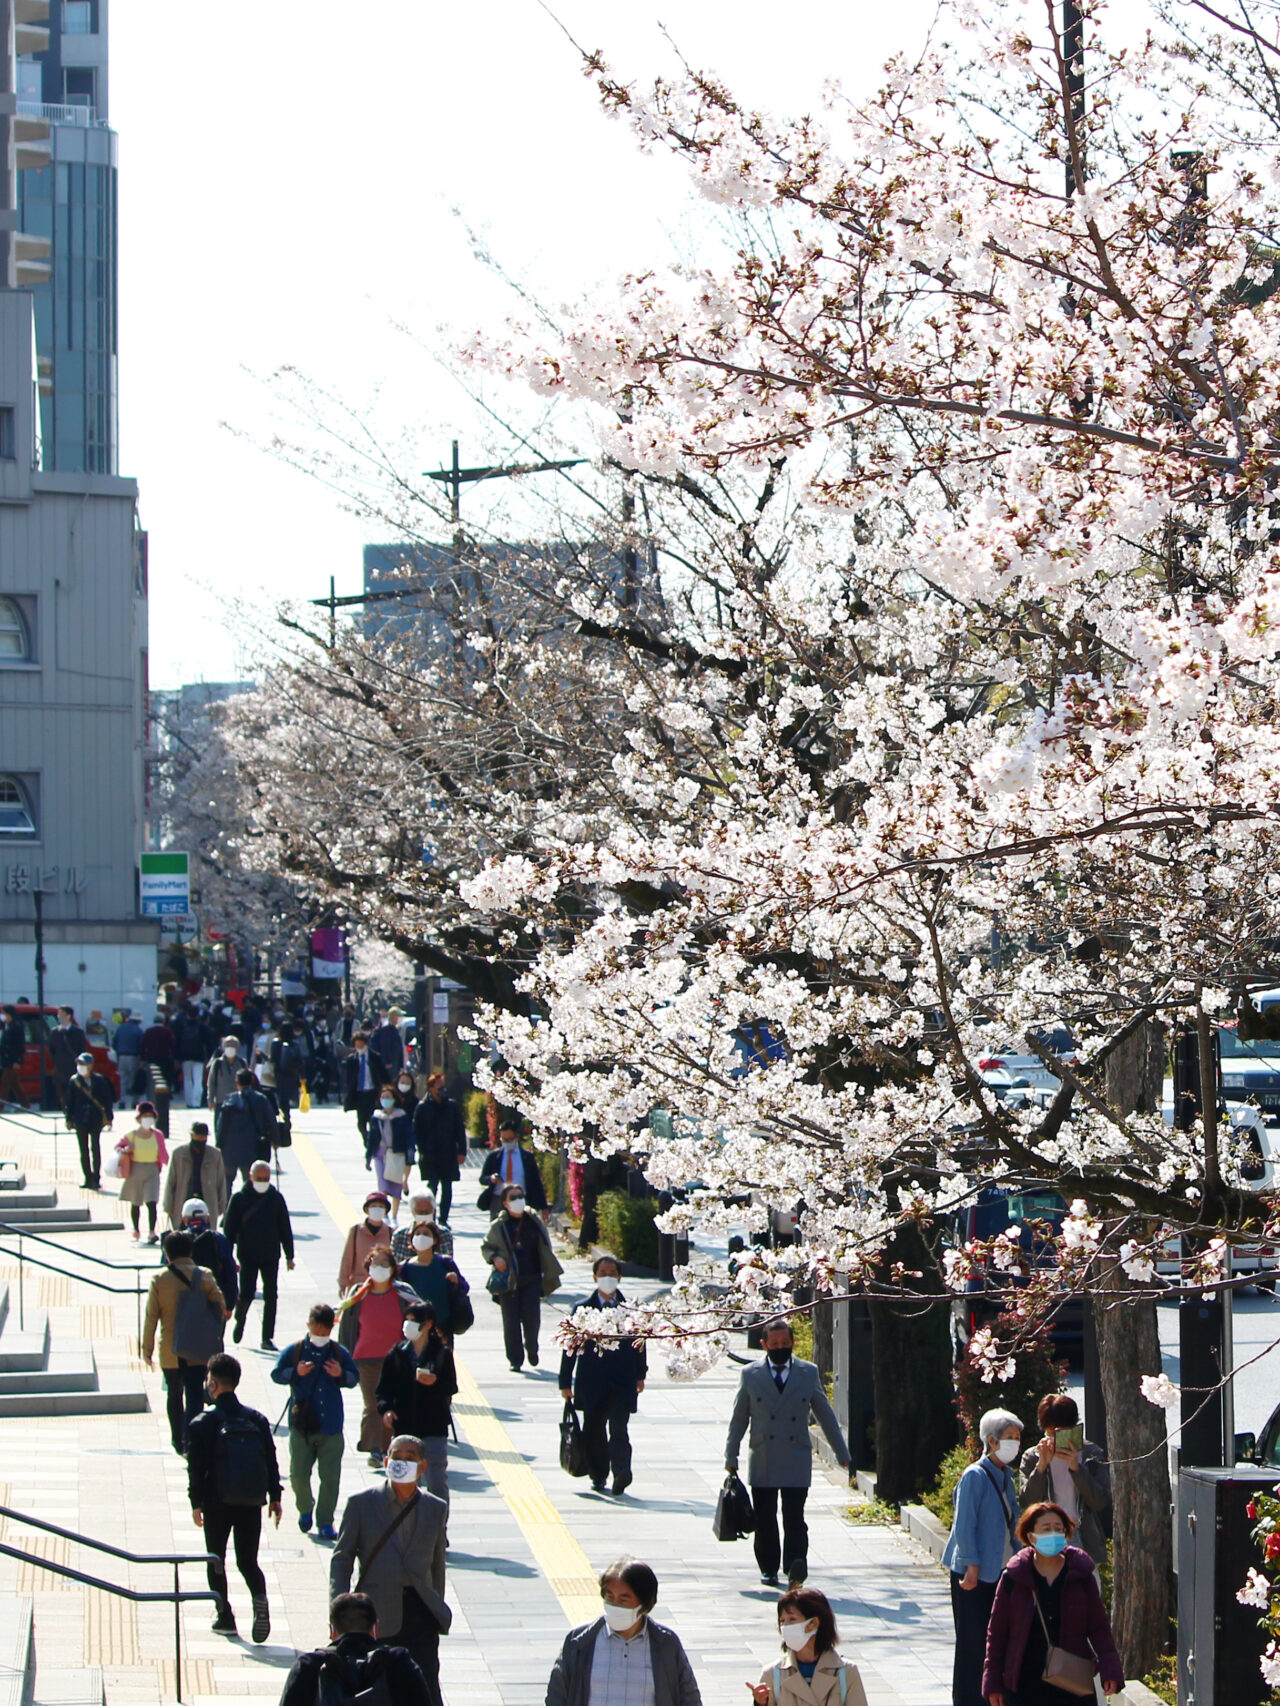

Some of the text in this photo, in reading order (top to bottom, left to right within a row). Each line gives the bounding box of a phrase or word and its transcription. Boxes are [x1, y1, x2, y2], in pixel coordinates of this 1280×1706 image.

[5, 864, 88, 895] 段ビル
[142, 880, 187, 891] FamilyMart
[161, 903, 185, 913] たばこ
